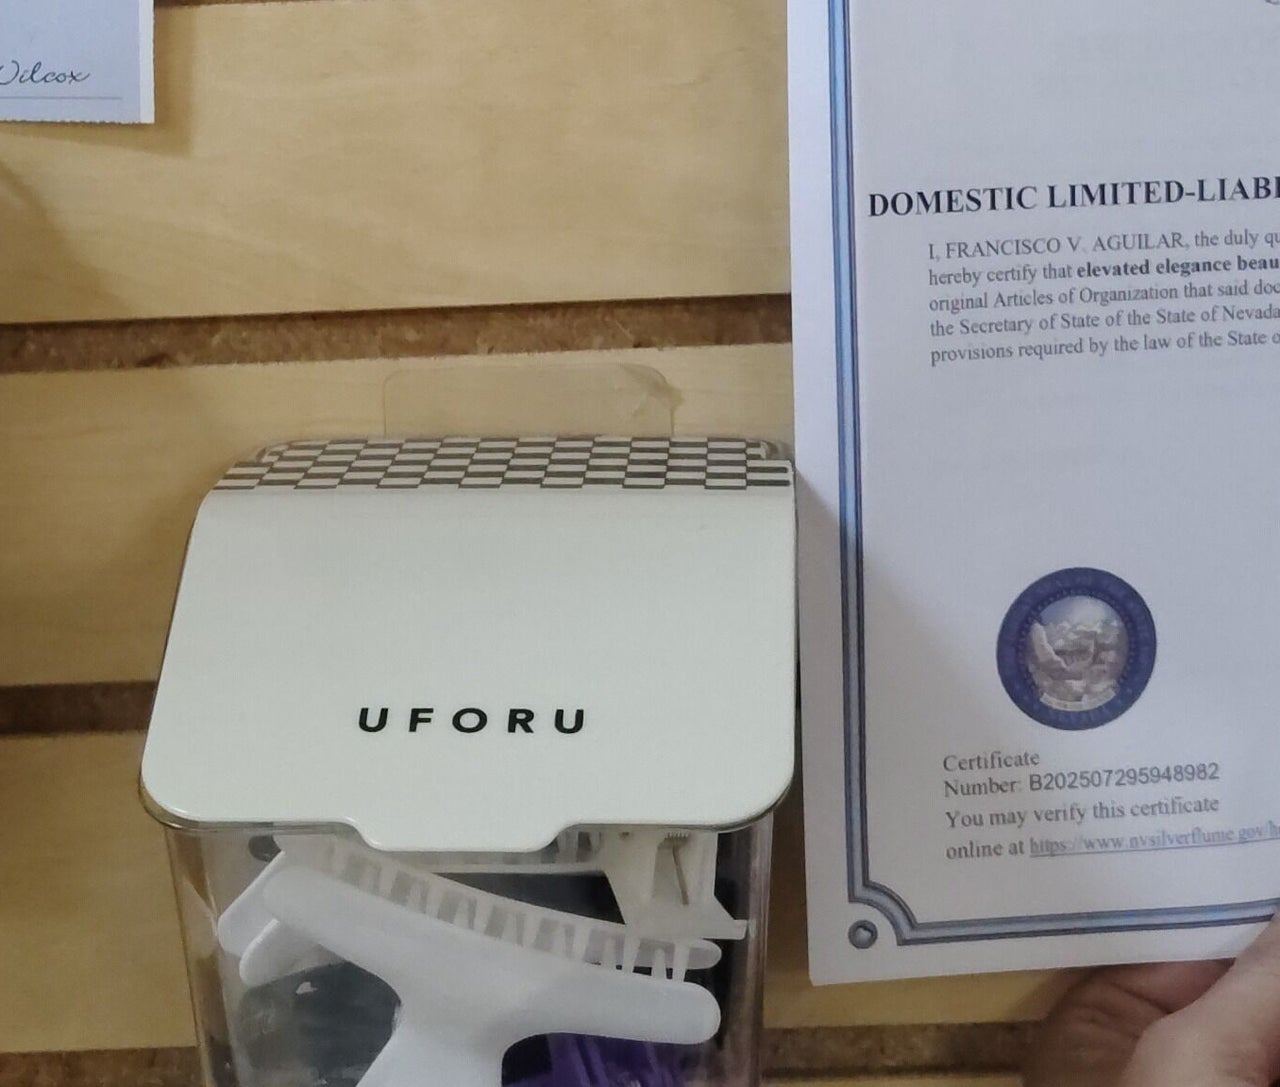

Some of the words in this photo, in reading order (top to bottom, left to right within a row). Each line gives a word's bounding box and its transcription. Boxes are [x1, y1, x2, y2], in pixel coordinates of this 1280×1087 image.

[869, 186, 1037, 217] DOMESTIC
[928, 267, 982, 288] hereby
[986, 263, 1038, 285] certify
[1042, 262, 1073, 280] that
[1076, 258, 1151, 279] elevated
[1155, 257, 1232, 278] elegance
[357, 707, 585, 734] UFORU
[942, 750, 1040, 772] Certificate
[1029, 762, 1220, 792] B202507295948982
[945, 810, 984, 829] You
[989, 811, 1027, 829] may
[1033, 802, 1087, 826] verify
[1092, 801, 1126, 820] this
[1129, 795, 1220, 817] certificate
[945, 839, 1004, 861] online
[1008, 839, 1025, 857] at
